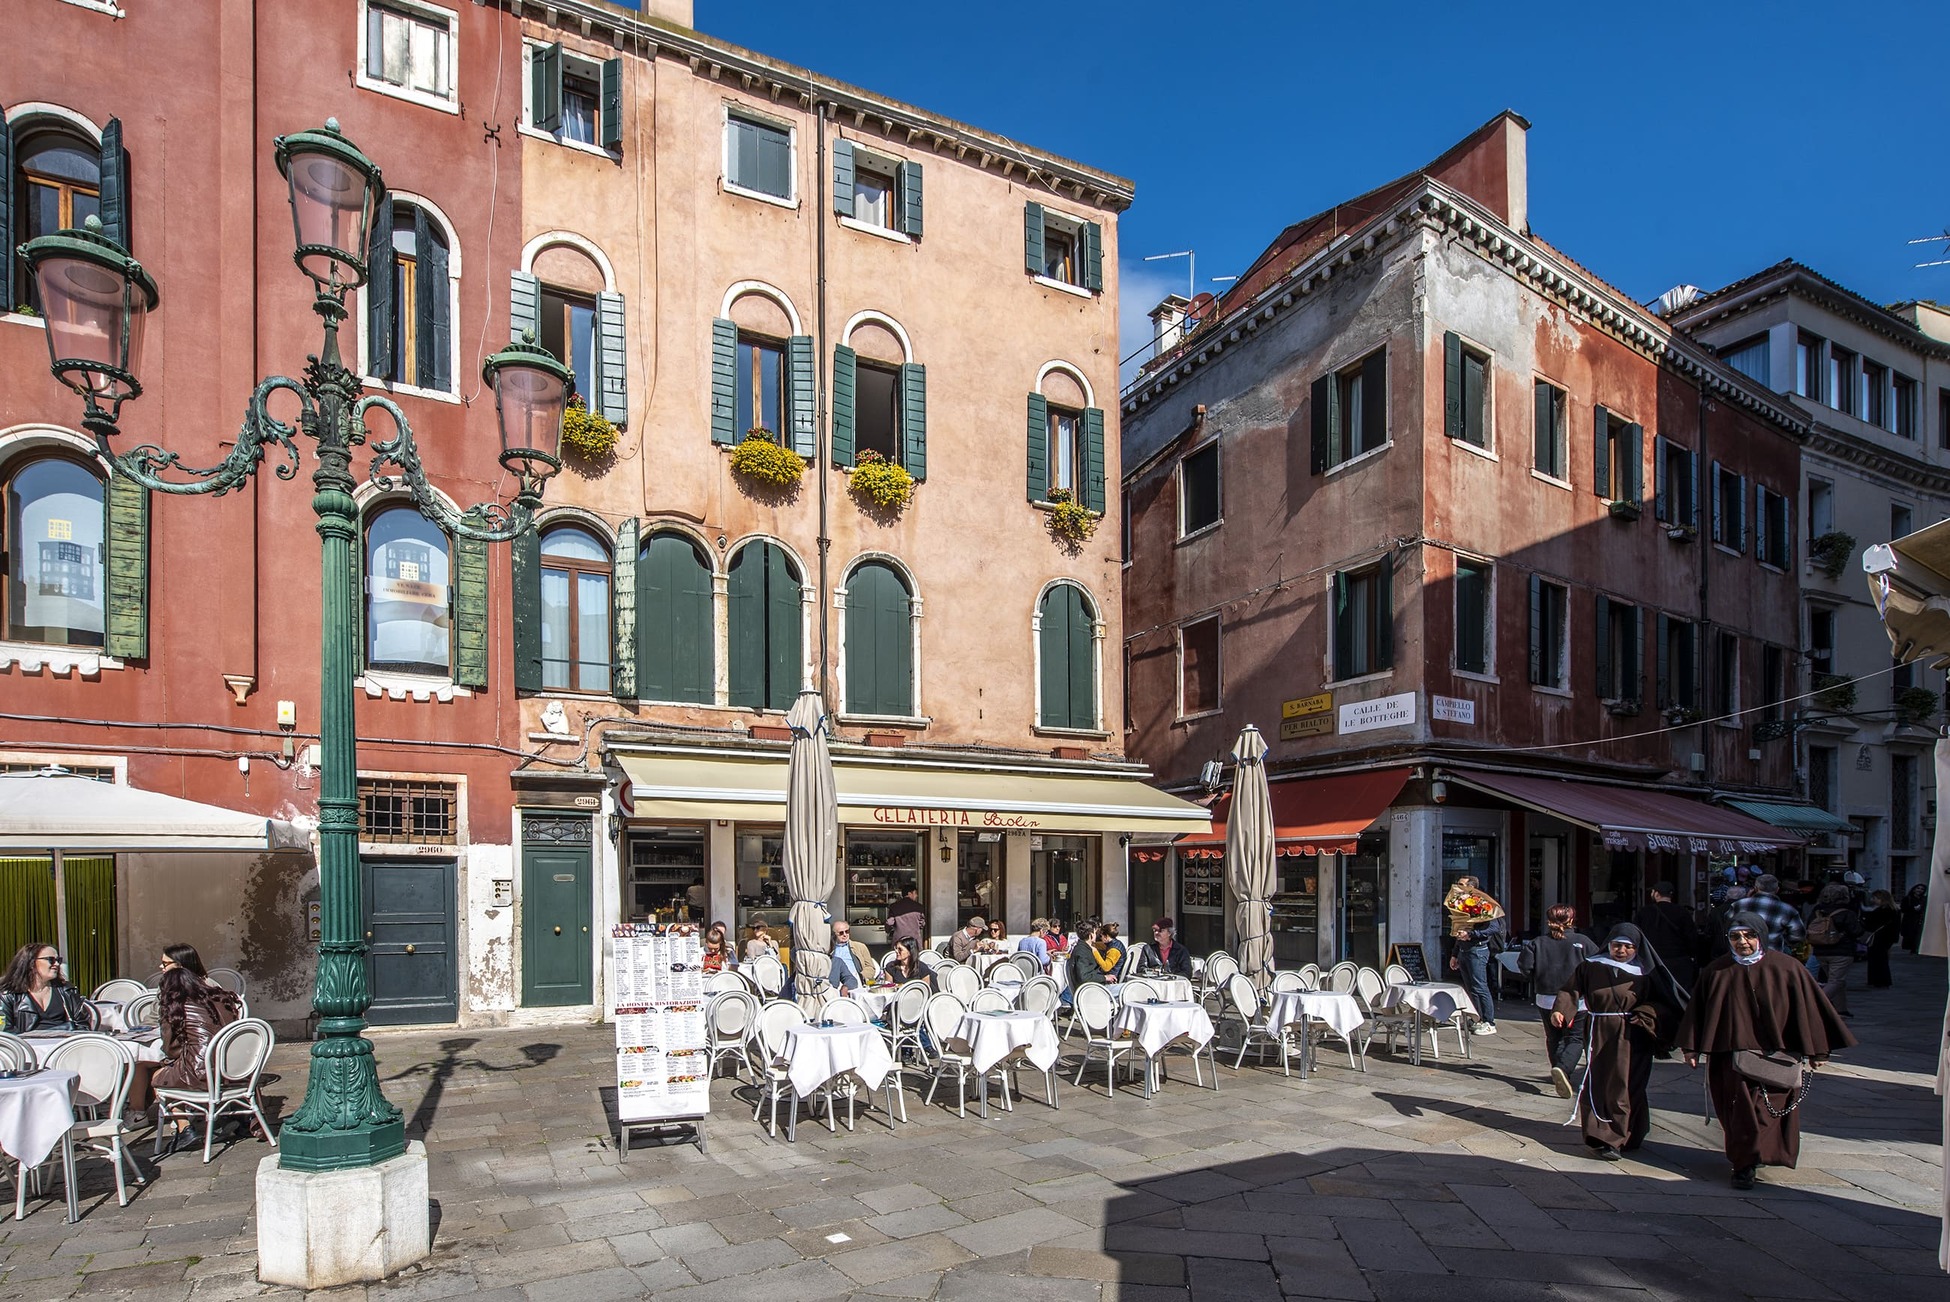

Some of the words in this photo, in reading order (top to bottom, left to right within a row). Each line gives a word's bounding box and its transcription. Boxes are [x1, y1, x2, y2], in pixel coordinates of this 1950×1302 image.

[1296, 699, 1324, 709] BARNABA
[1353, 703, 1382, 715] CALLE
[1386, 700, 1399, 710] DE
[1436, 698, 1471, 710] CAMPIELLO
[1344, 718, 1356, 728] LE
[1360, 710, 1409, 724] BOTTEGHE
[1442, 709, 1471, 719] STEFANO
[1284, 723, 1298, 731] PER
[1300, 718, 1329, 729] RIALTO
[577, 798, 596, 806] 2961
[873, 807, 969, 825] GELATERIA
[983, 810, 1041, 828] Paolin
[1646, 833, 1680, 850] Snack
[1687, 836, 1708, 853] Bar
[418, 846, 443, 854] 2960
